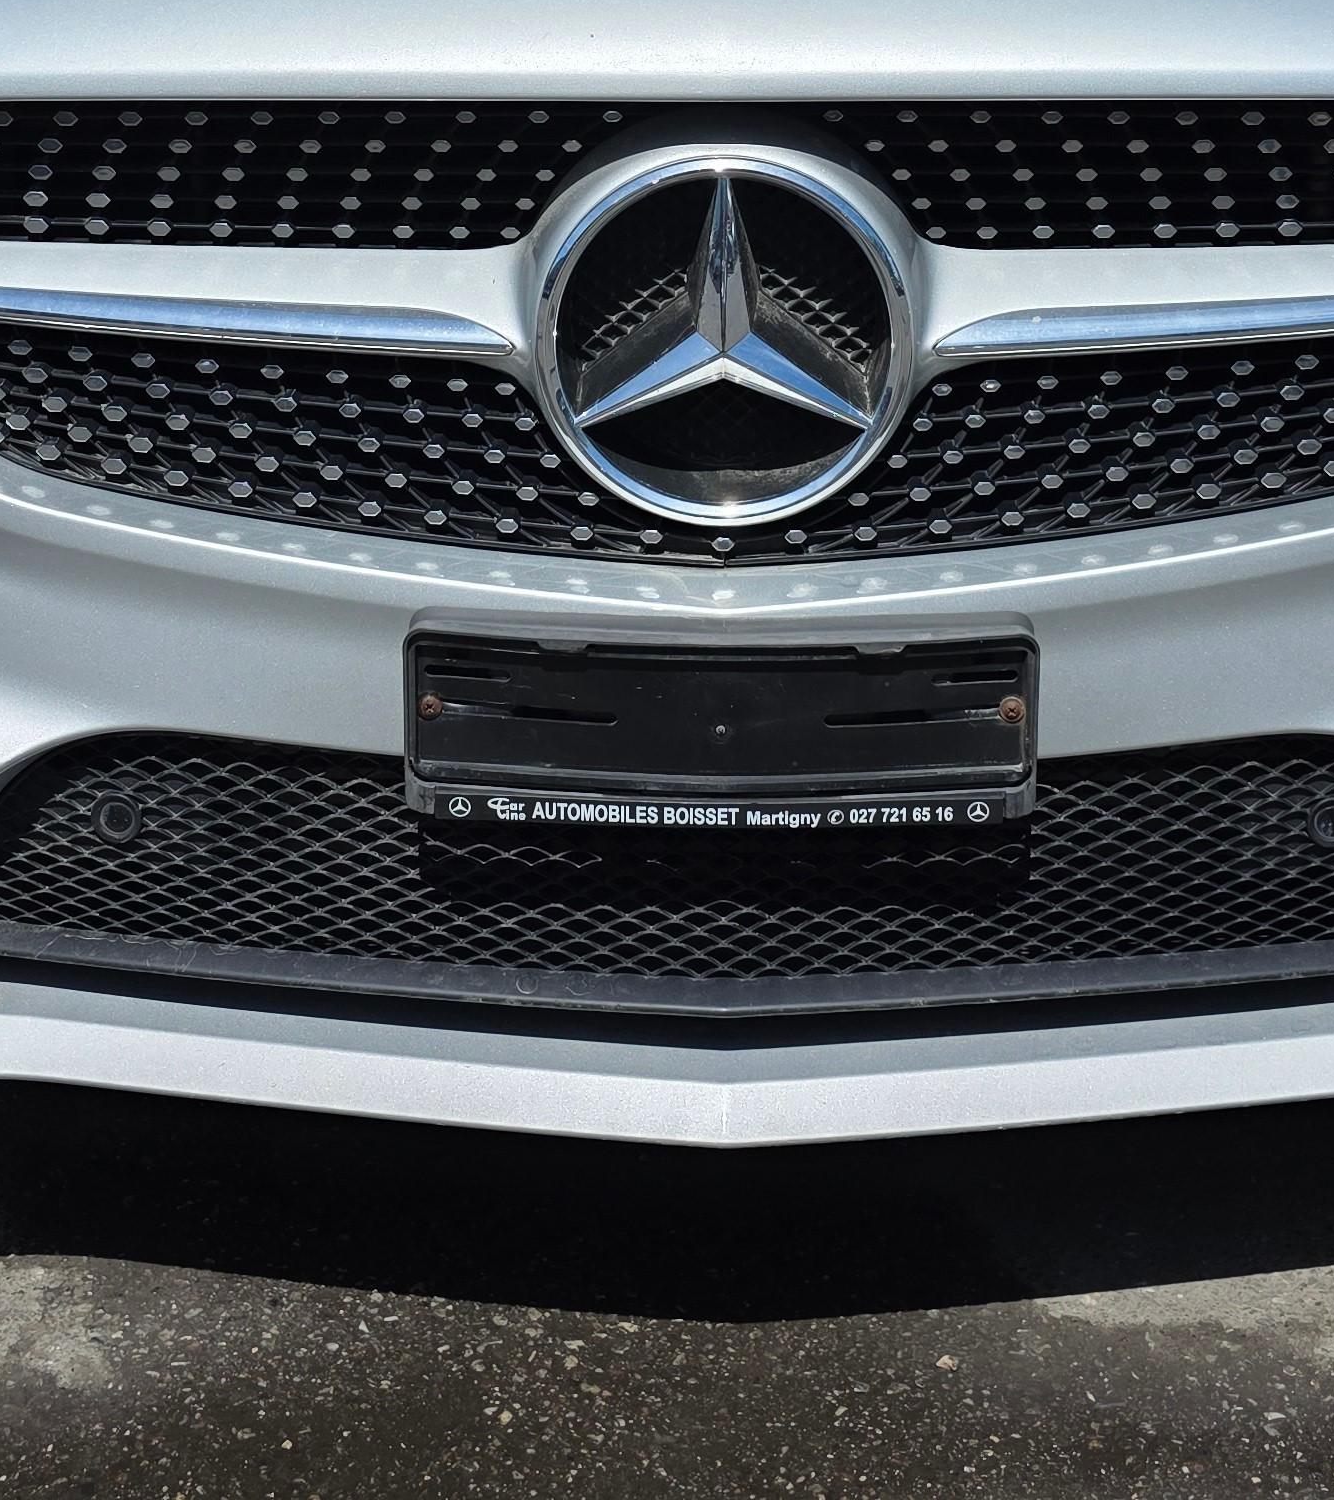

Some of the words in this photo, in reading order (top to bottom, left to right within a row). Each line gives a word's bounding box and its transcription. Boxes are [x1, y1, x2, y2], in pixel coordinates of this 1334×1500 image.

[532, 801, 658, 825] AUTOMOBILES
[663, 806, 740, 826] BOISSET
[746, 809, 821, 828] Martigny
[849, 808, 874, 824] 027
[881, 807, 907, 823] 721
[912, 806, 931, 822] 65
[935, 806, 954, 822] 16
